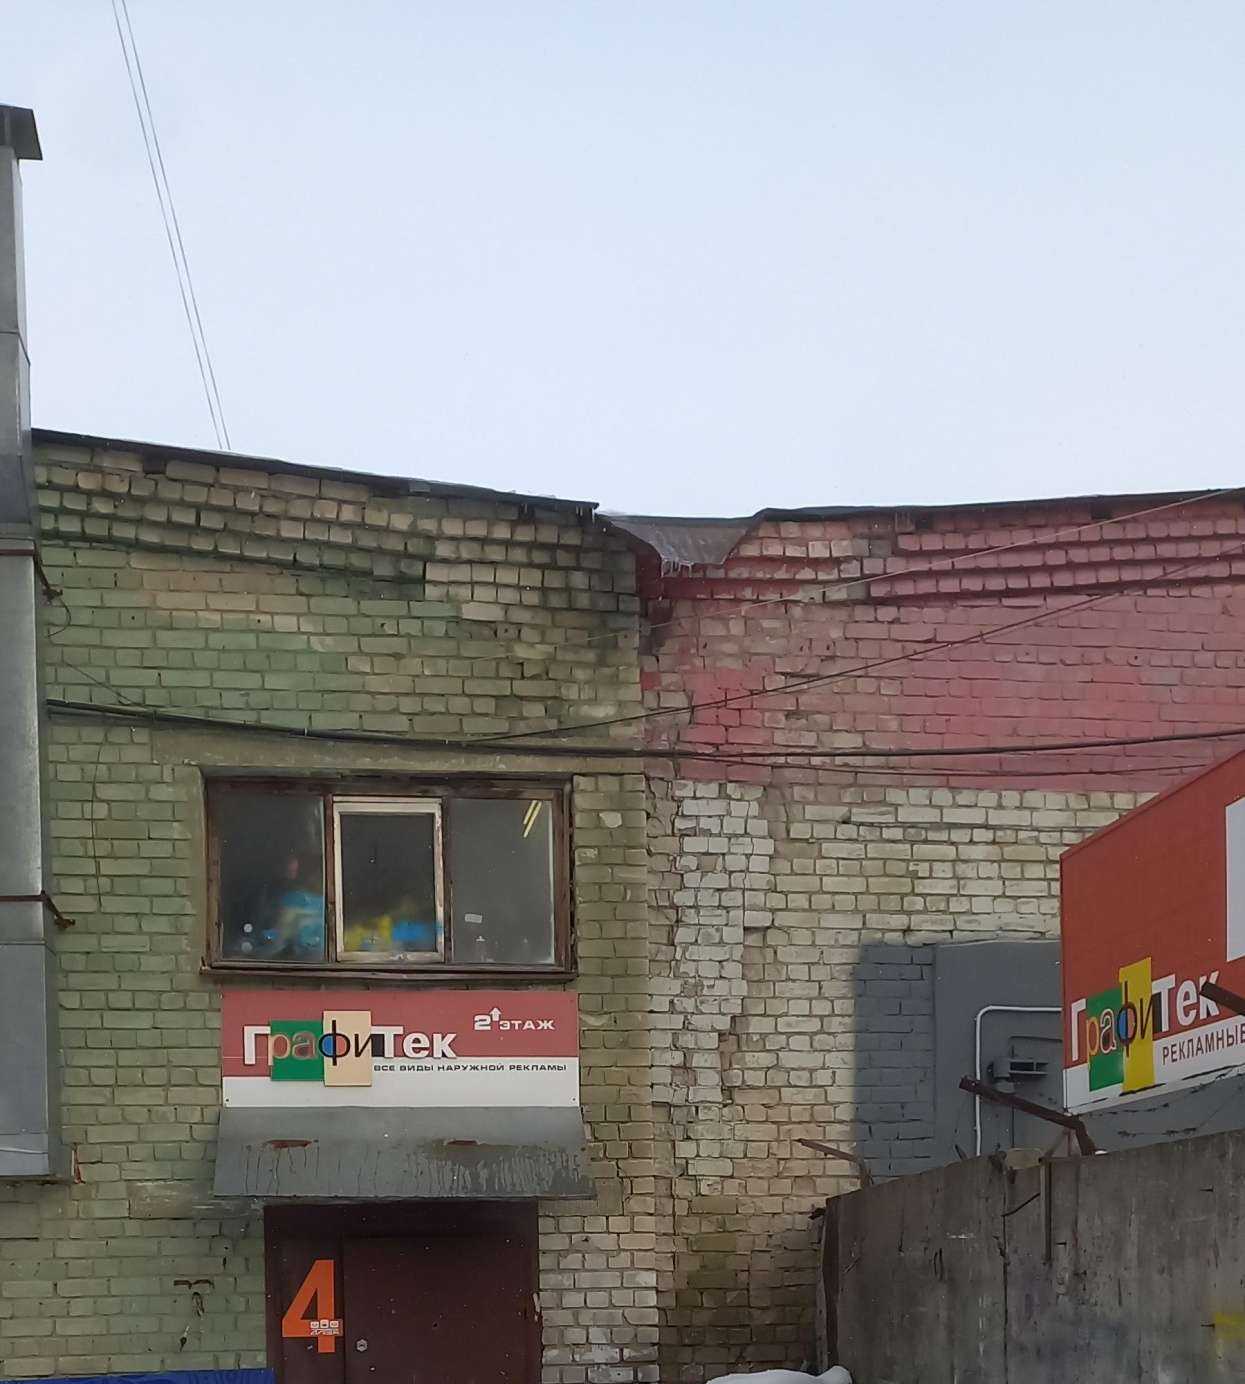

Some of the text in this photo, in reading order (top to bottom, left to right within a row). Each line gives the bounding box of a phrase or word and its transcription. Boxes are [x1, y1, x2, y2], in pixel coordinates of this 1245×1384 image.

[474, 1014, 555, 1031] 2 ЭТАЖ
[373, 1062, 567, 1072] ВСЕ ВИДЫ НАРУЖНОЙ РЕКЛАМЫ
[282, 1260, 344, 1353] 4
